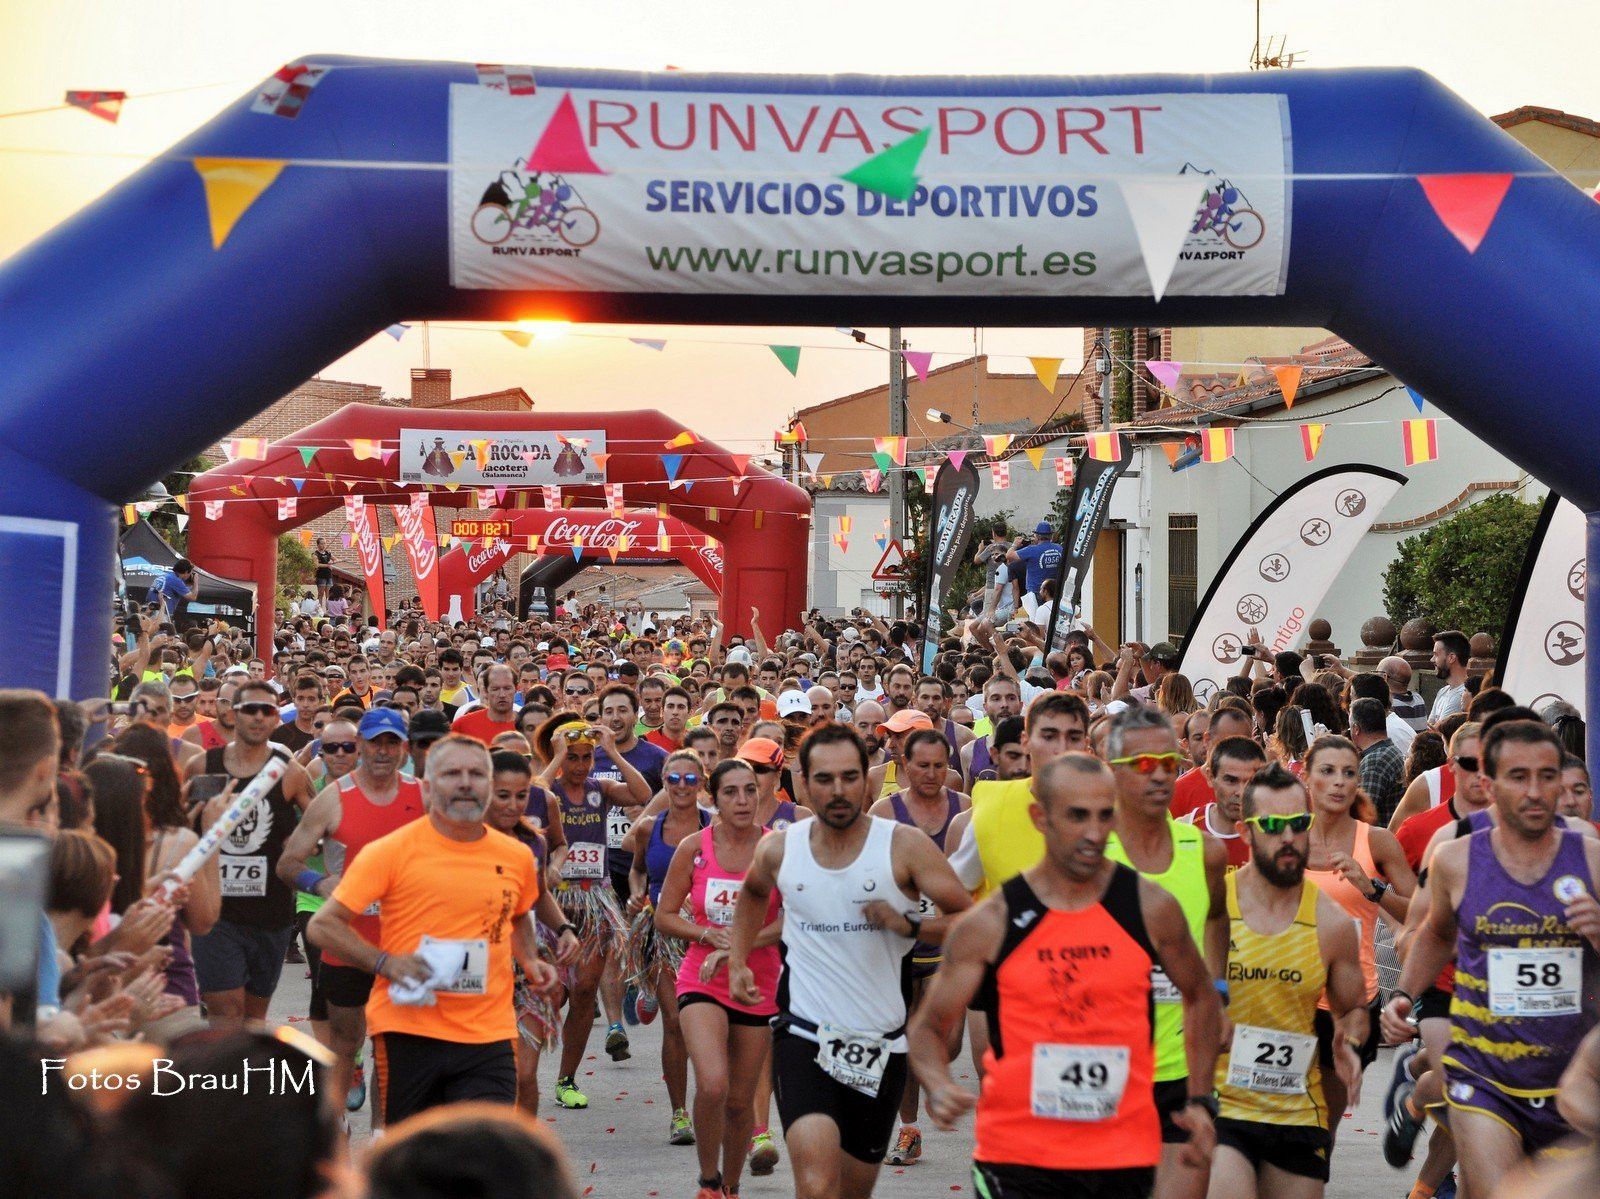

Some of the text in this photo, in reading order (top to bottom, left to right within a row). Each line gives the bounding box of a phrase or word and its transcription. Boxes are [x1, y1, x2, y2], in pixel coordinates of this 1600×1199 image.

[588, 100, 1162, 155] RUNVASPORT
[645, 180, 1098, 218] SERVICIOS DEPORTIVOS
[492, 246, 582, 259] RUNVASPORT
[645, 243, 1097, 282] www.runvasport.es
[1177, 249, 1246, 260] NVASPORT
[543, 516, 643, 549] Coca-Cola
[567, 850, 600, 863] 433
[220, 864, 261, 880] 176
[800, 921, 841, 933] Triatlon
[1516, 962, 1561, 987] 58
[827, 1038, 883, 1069] 187
[1254, 1042, 1293, 1067] 23
[1060, 1061, 1109, 1088] 49
